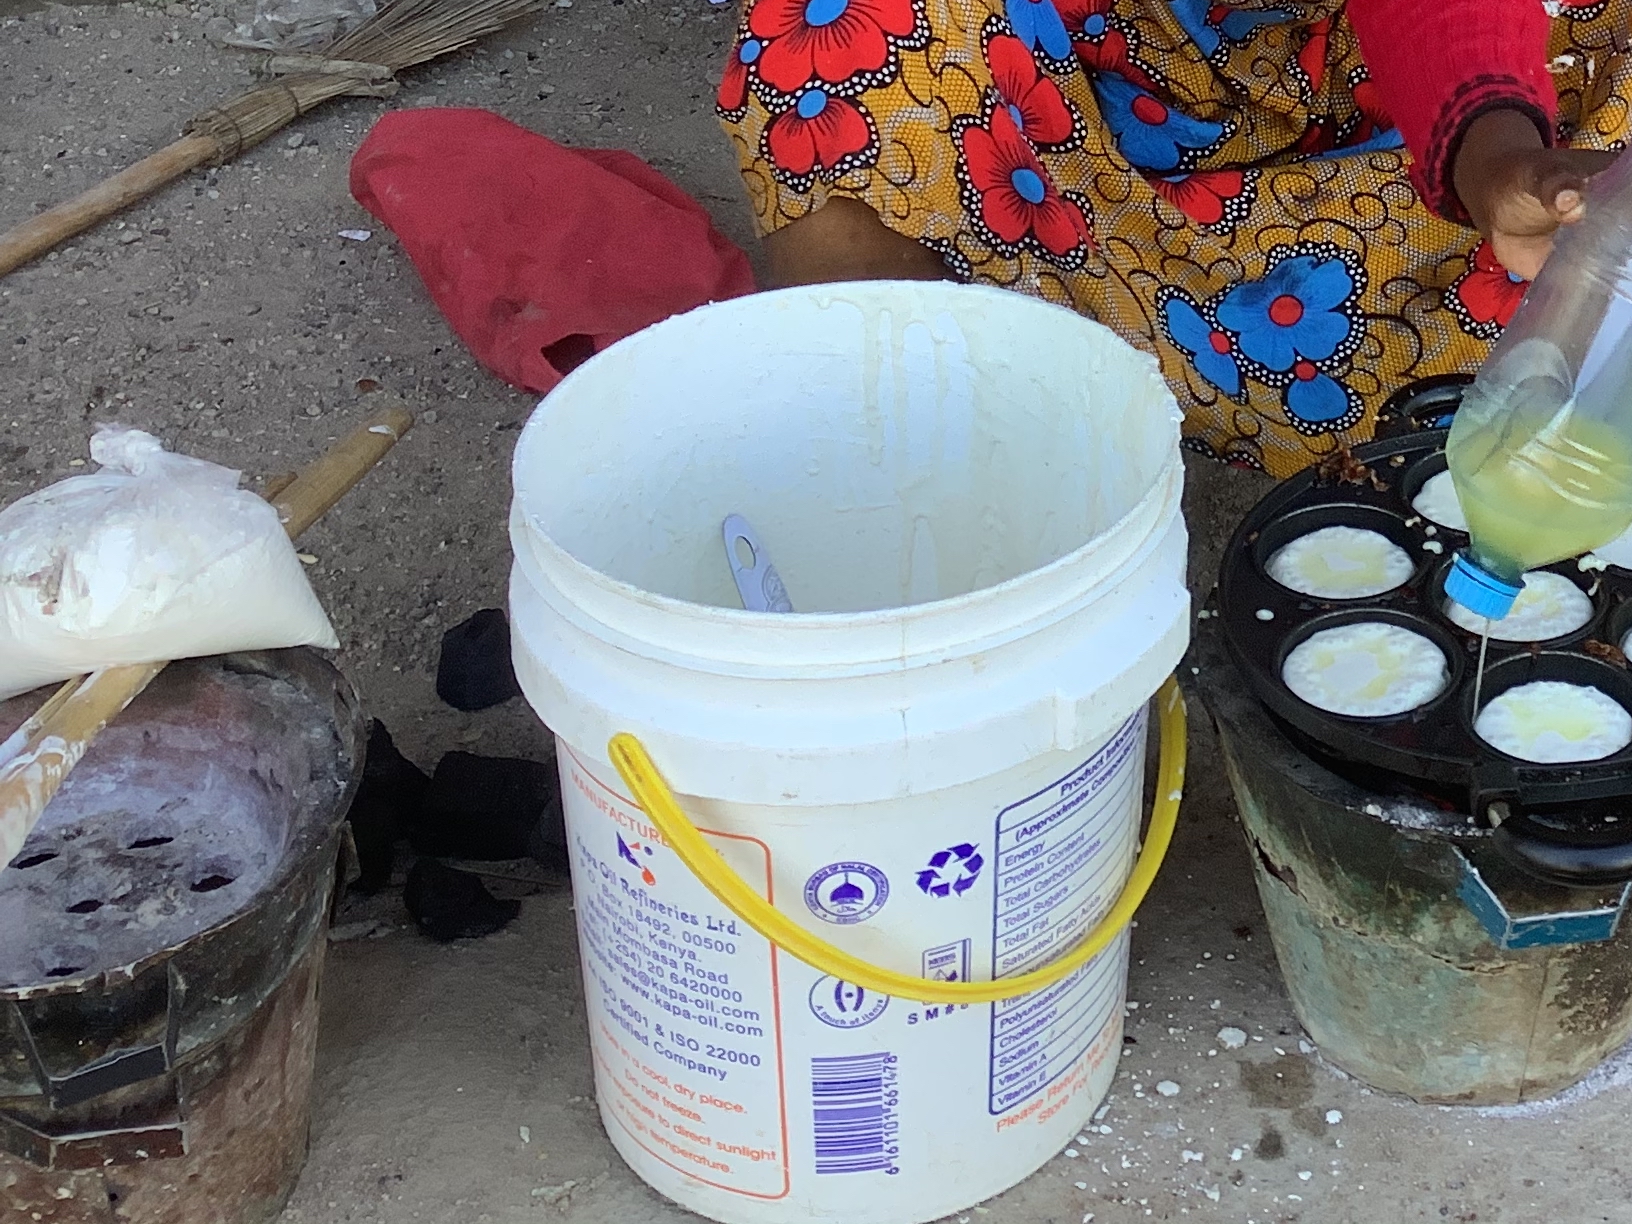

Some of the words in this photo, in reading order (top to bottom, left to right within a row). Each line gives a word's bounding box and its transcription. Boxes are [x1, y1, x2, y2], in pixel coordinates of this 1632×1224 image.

[1060, 755, 1106, 796] Product
[1014, 788, 1090, 842] (Approximate
[1003, 860, 1045, 888] Protein
[1046, 832, 1085, 865] Content
[1004, 840, 1046, 867] Energy
[620, 877, 700, 926] Refineries
[706, 915, 743, 937] Ltd.
[1002, 908, 1031, 928] Total
[1033, 885, 1069, 913] Sugars
[1003, 888, 1031, 908] Total
[612, 921, 679, 970] Mombasa
[684, 961, 730, 986] Road
[682, 930, 737, 956] 00500
[1001, 929, 1030, 949] Total
[1032, 917, 1051, 939] Fat
[1002, 935, 1054, 969] Saturated
[646, 960, 666, 979] 20
[669, 972, 744, 1004] 6420000
[620, 975, 764, 1038] www.kapa-oil.com
[1000, 1006, 1059, 1048] Cholesterol
[619, 998, 650, 1028] 9001
[654, 1023, 666, 1039] &
[669, 1030, 701, 1053] ISO
[705, 1044, 761, 1068] 22000
[999, 1039, 1040, 1068] Sodium
[652, 1041, 728, 1082] Company
[998, 1059, 1037, 1086] Vitamin
[673, 1082, 696, 1101] dry
[997, 1079, 1036, 1107] Vitamin
[1036, 1093, 1071, 1124] Store
[996, 1097, 1044, 1132] Please
[657, 1113, 671, 1129] to
[673, 1123, 713, 1146] direct
[715, 1139, 777, 1162] sunlight
